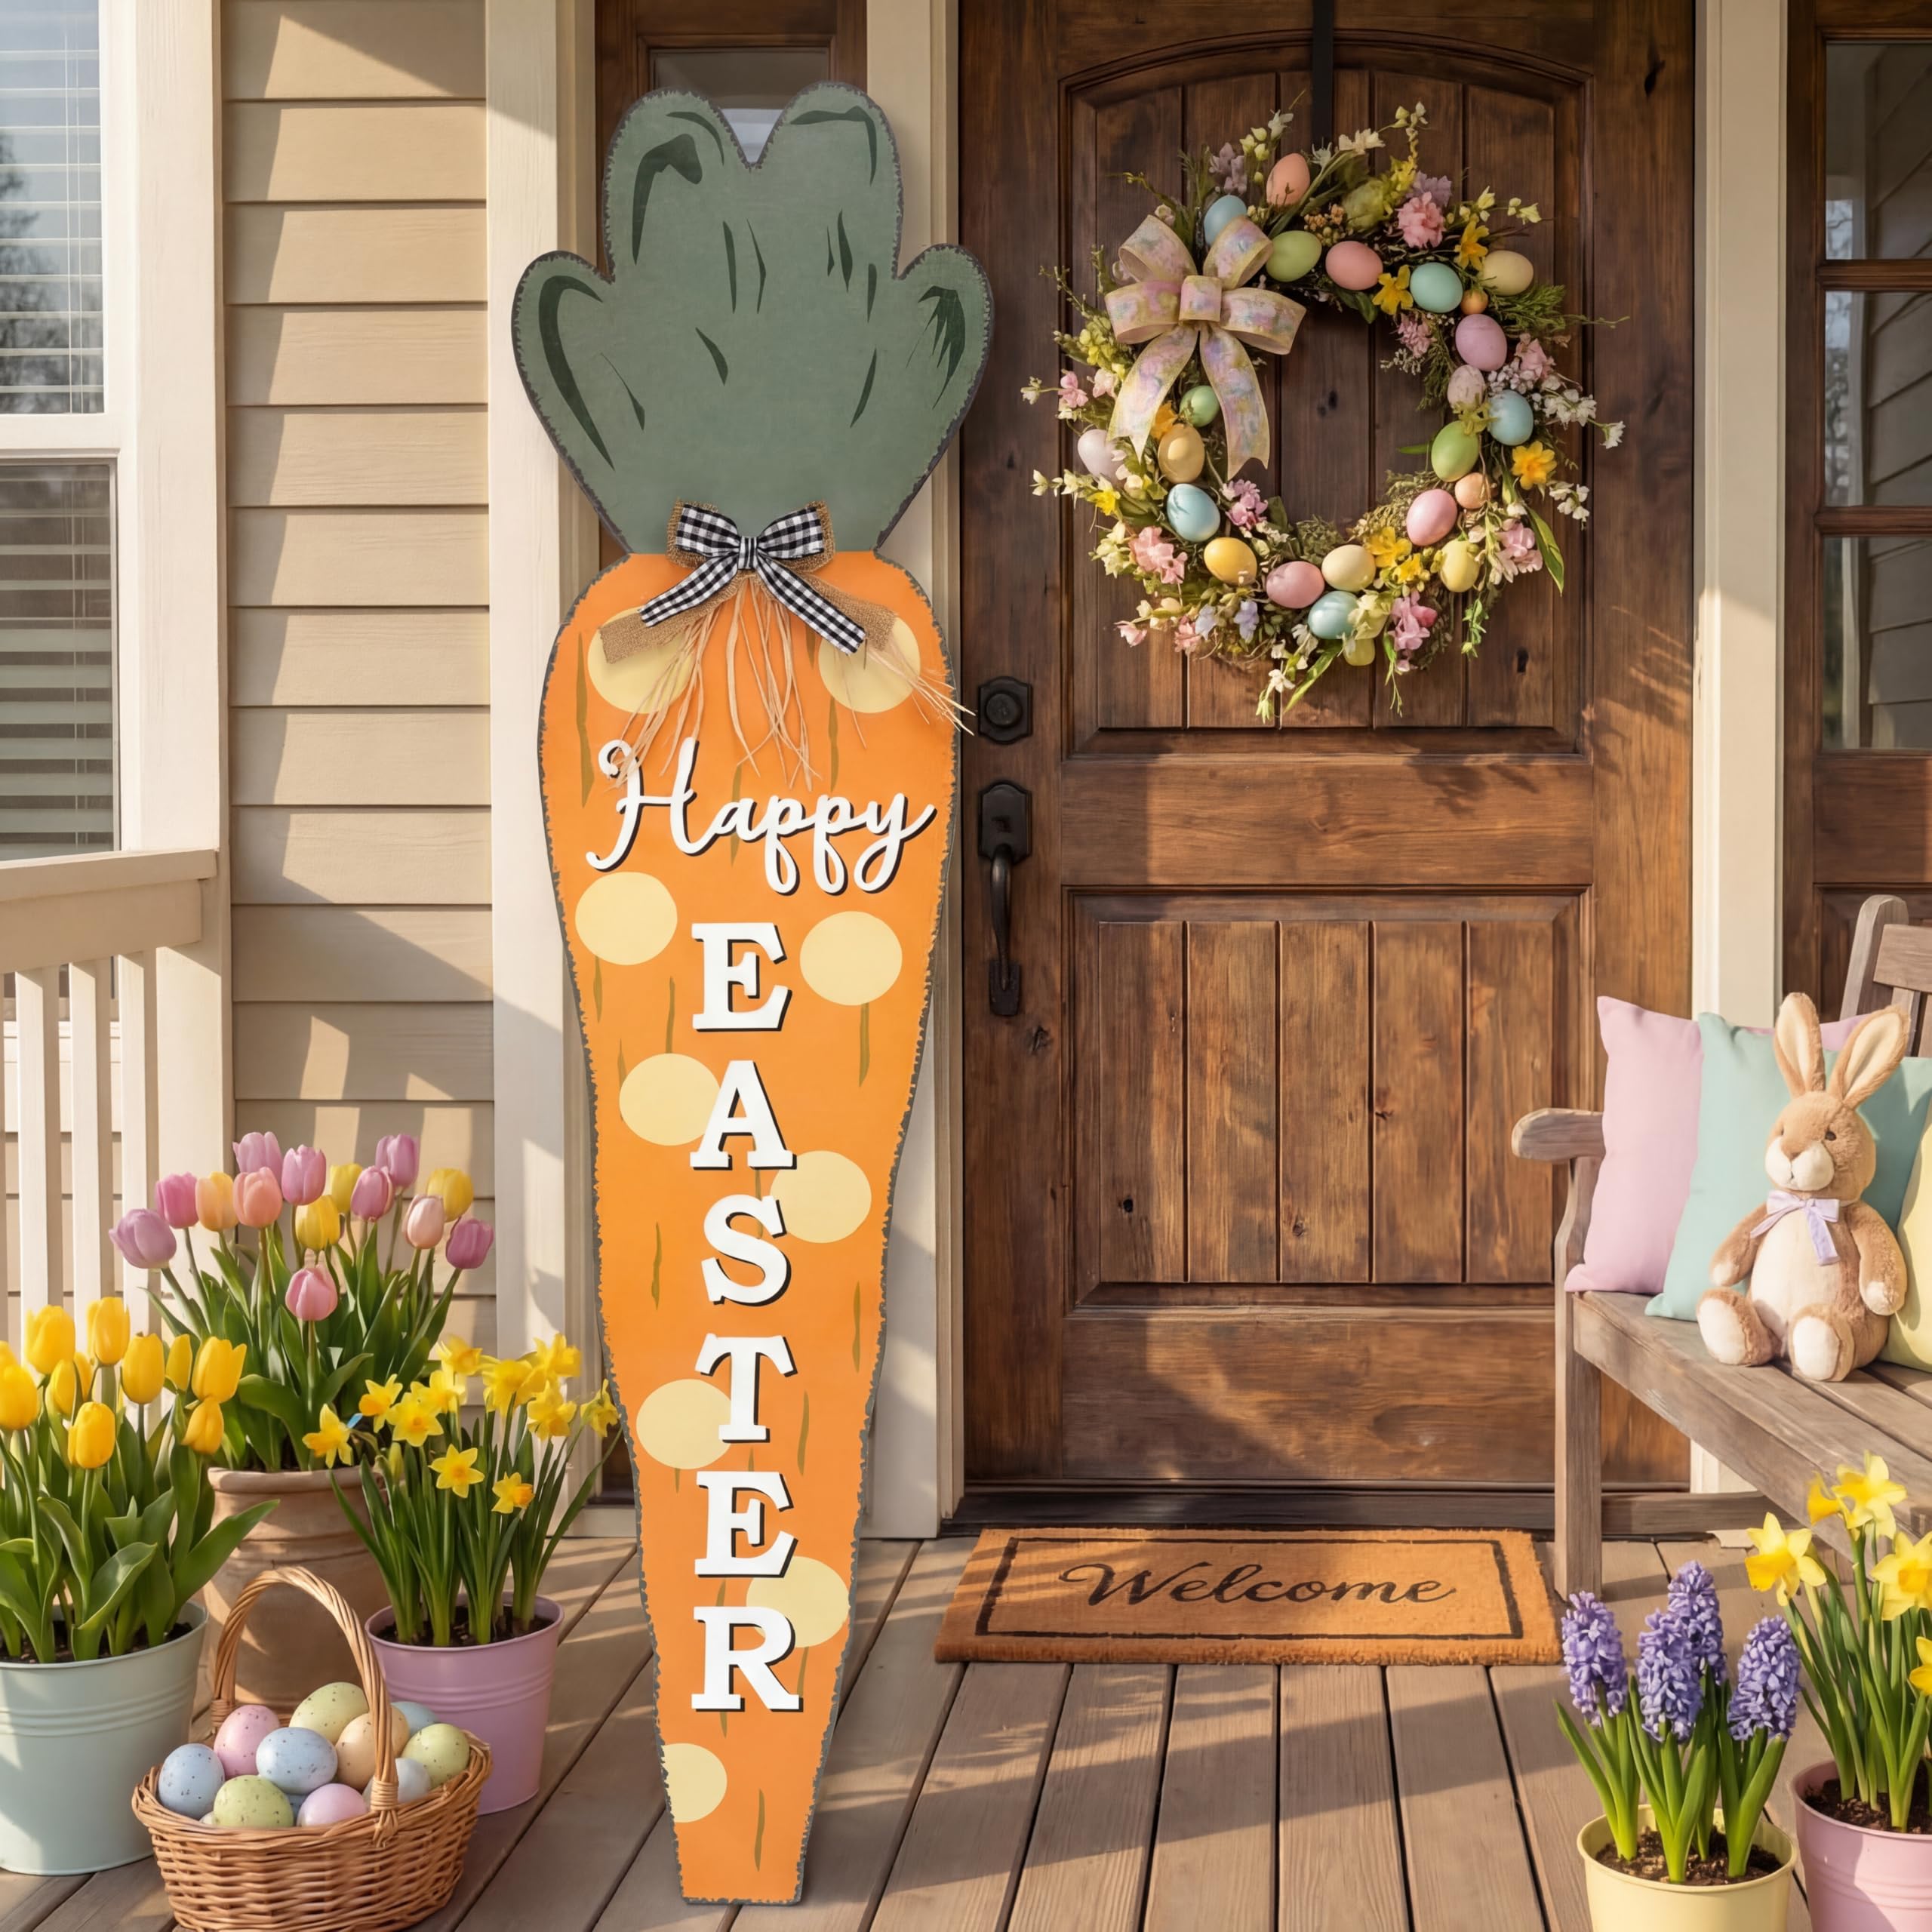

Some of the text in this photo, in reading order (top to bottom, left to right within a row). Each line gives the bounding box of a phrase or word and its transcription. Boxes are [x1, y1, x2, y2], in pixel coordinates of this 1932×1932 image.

[586, 737, 937, 895] Happy
[690, 921, 802, 1712] EASTER
[1059, 1561, 1456, 1606] Welcome
